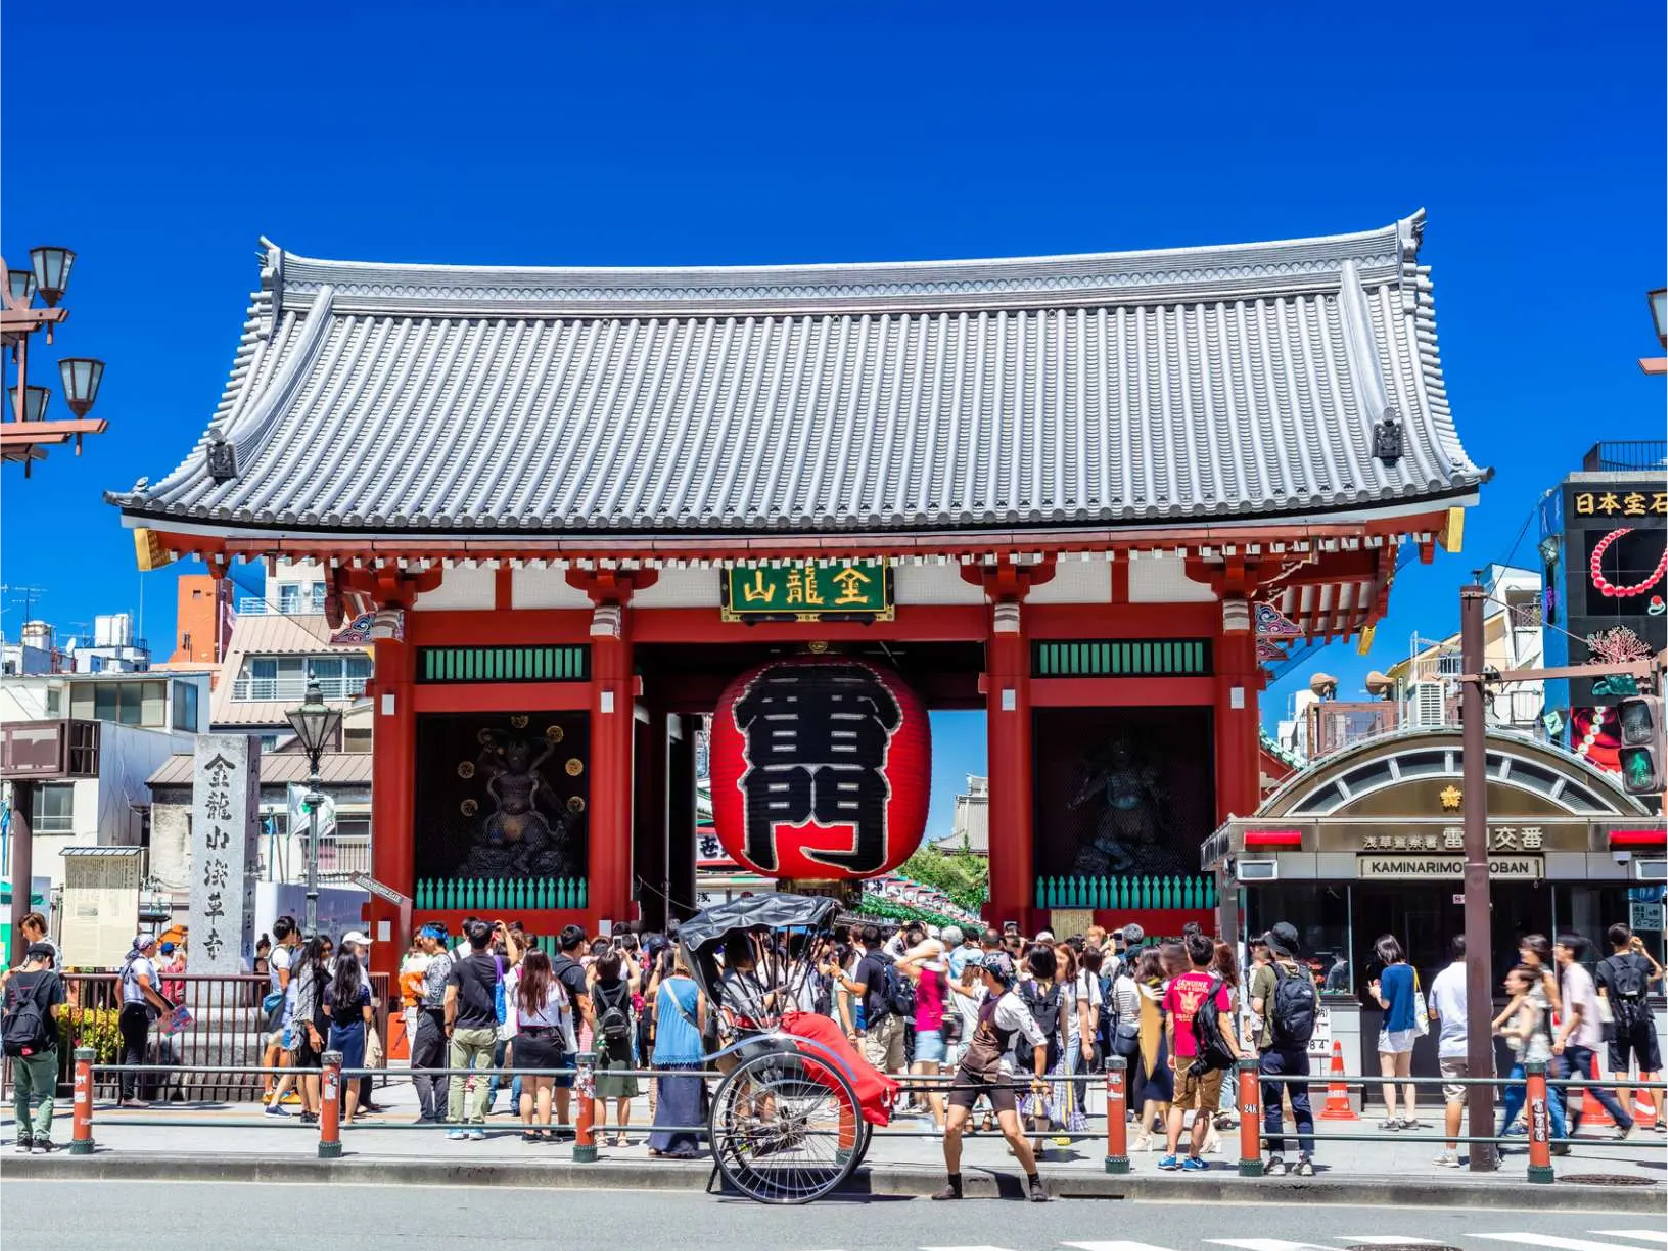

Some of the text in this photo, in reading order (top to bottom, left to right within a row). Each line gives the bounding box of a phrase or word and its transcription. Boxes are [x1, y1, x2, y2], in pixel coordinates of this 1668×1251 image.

[1576, 492, 1667, 515] 日本宝石
[1364, 826, 1543, 850] 浅草警察署 雷交番
[1372, 861, 1529, 873] KAMINARIMO OBAN
